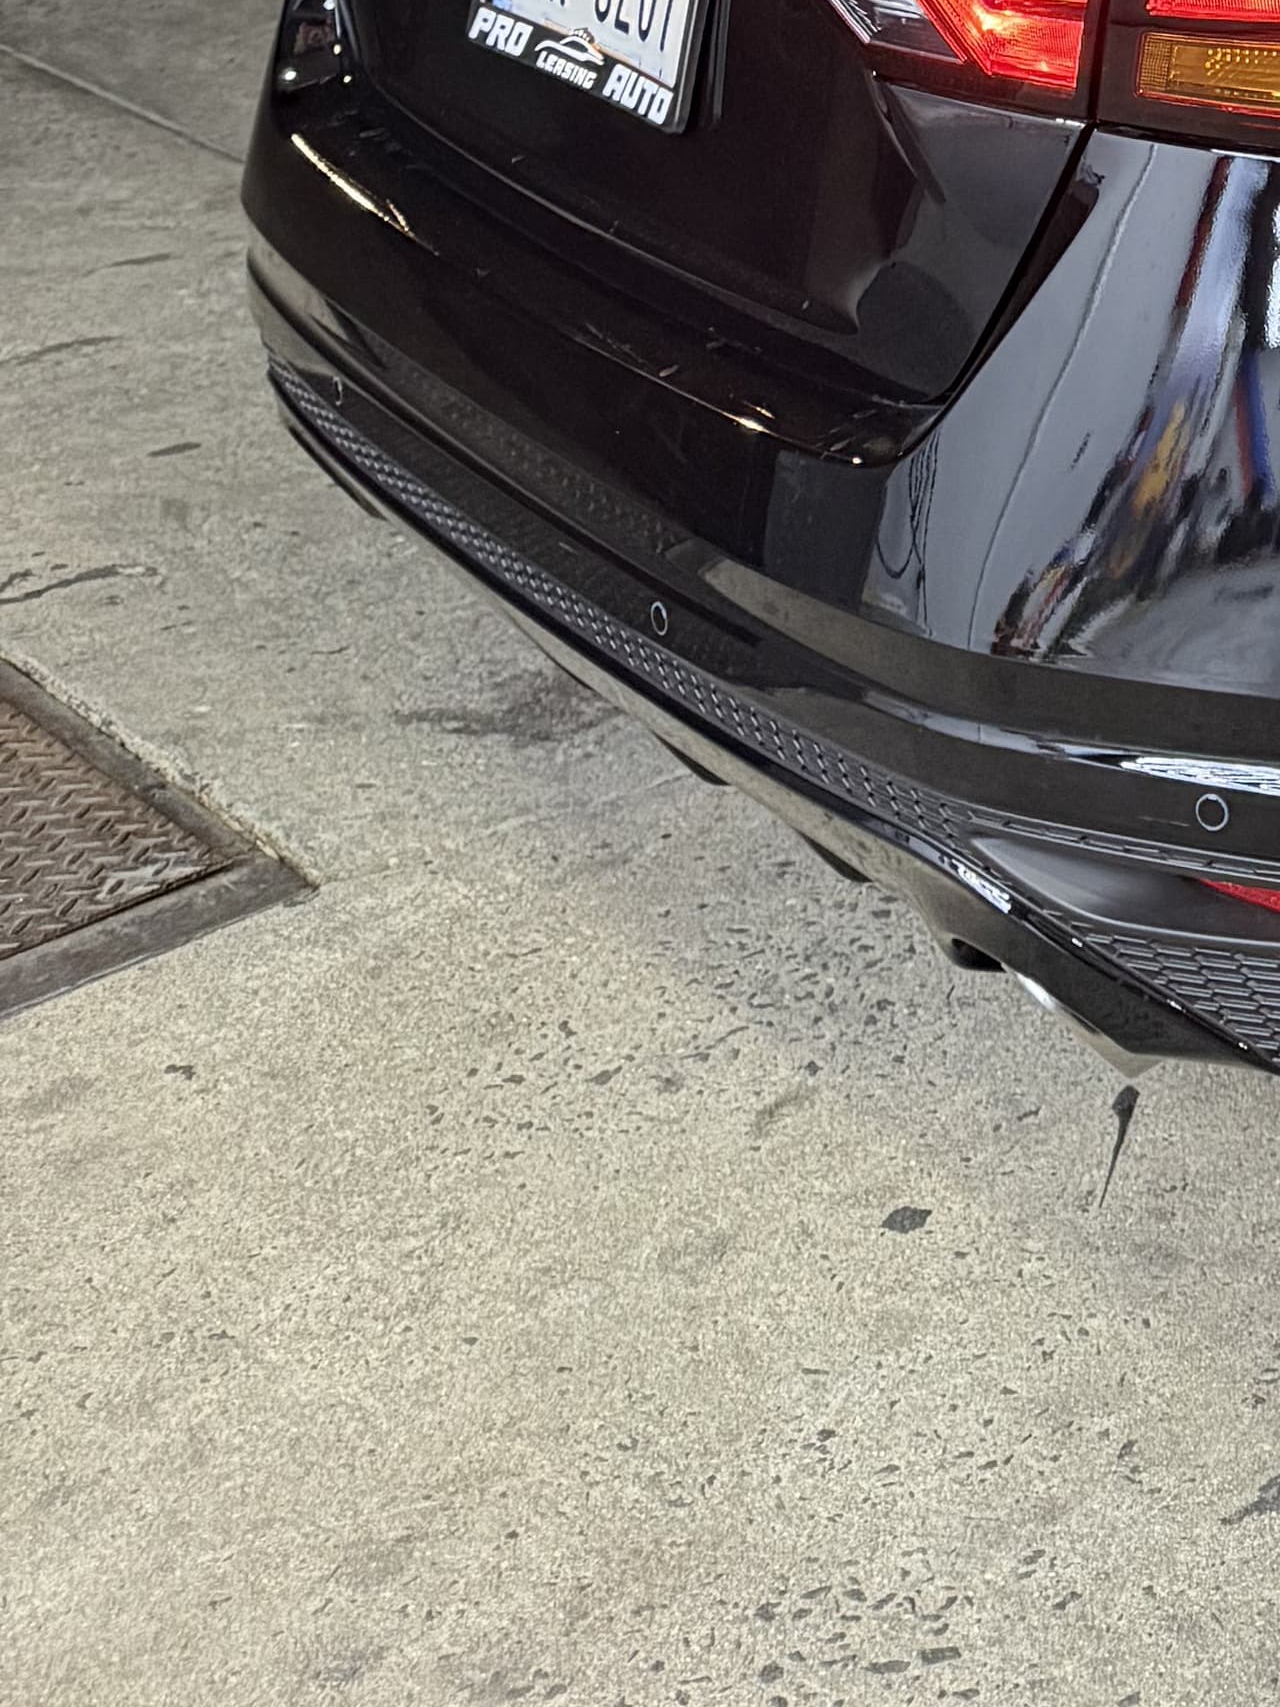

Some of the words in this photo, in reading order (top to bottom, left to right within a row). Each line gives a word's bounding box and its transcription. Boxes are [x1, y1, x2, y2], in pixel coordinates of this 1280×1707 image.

[468, 7, 534, 57] PRO
[536, 51, 598, 90] LEASING
[602, 63, 674, 126] AUTO
